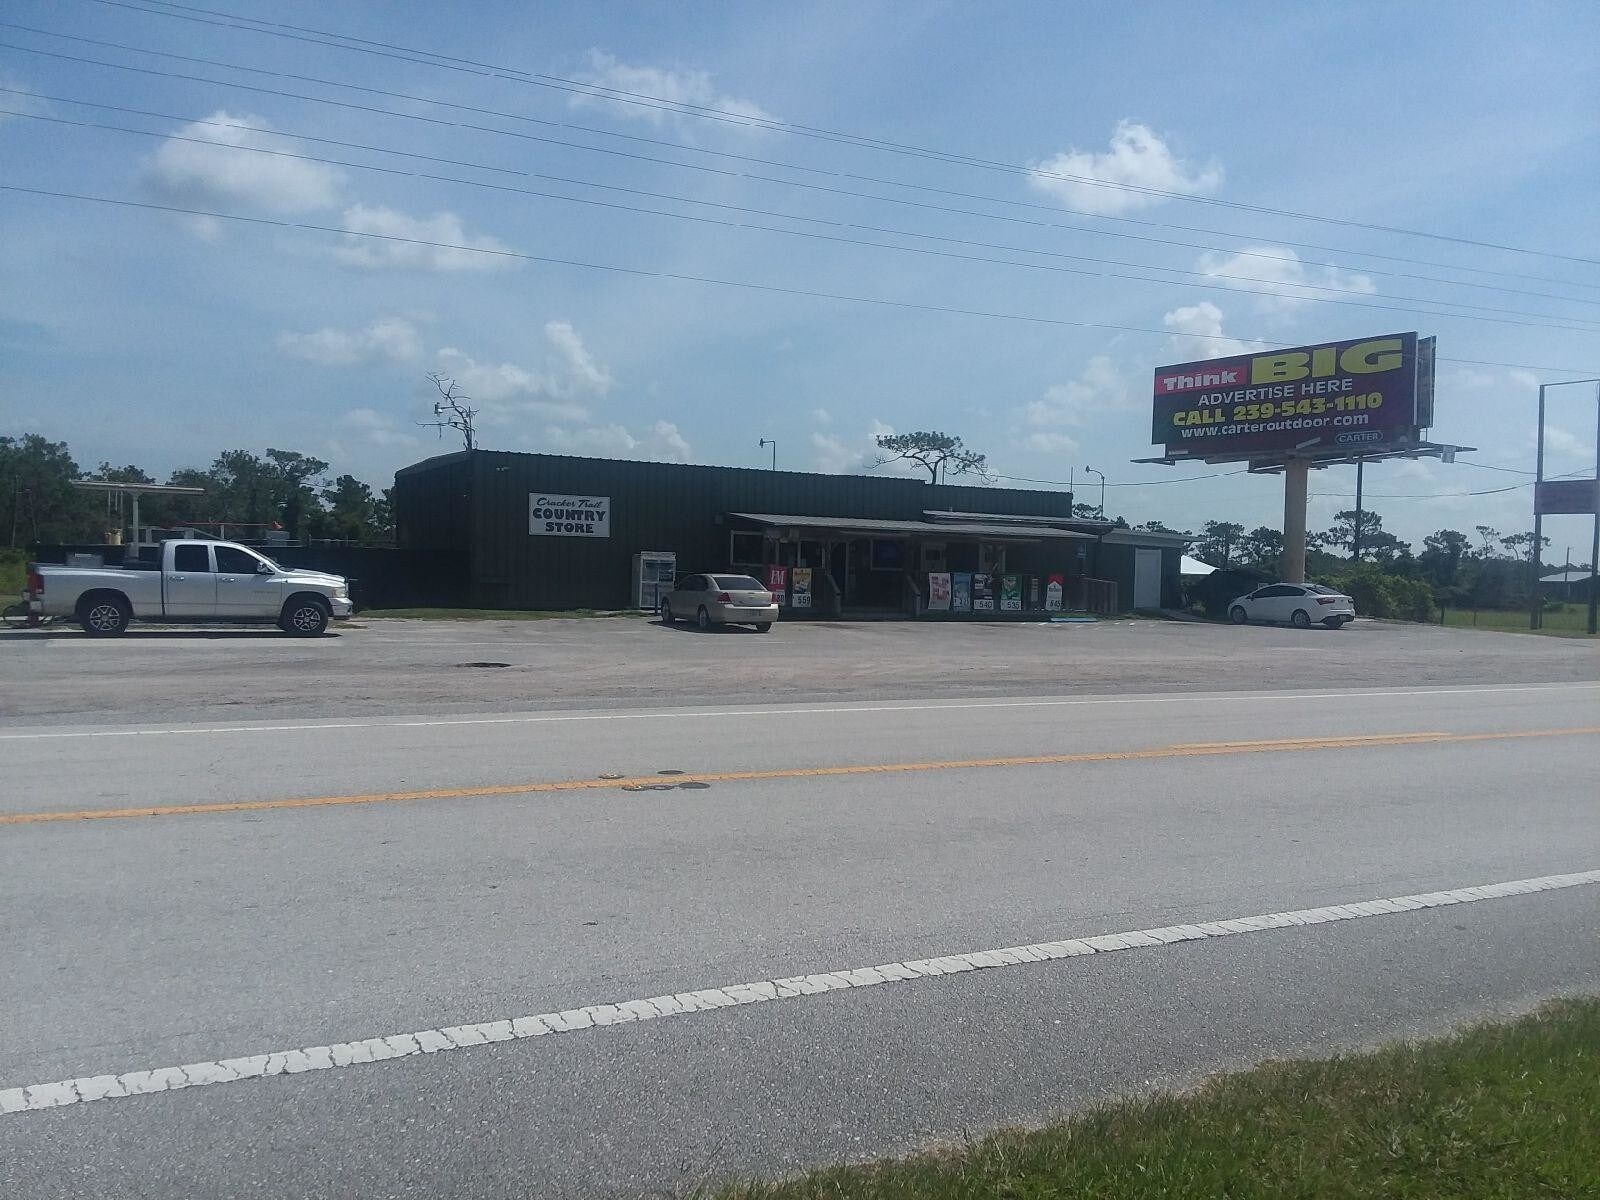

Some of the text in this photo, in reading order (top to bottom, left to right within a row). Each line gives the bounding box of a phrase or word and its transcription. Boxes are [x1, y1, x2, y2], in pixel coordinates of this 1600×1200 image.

[1164, 338, 1402, 391] Think BIG
[1198, 378, 1352, 406] ADVERTISE HERE
[1173, 392, 1382, 426] CALL 239-543-1110
[1181, 412, 1368, 438] www.carteroutdoor.com
[1338, 432, 1379, 443] CARTER
[532, 508, 606, 521] COUNTRY
[545, 522, 594, 533] STORE
